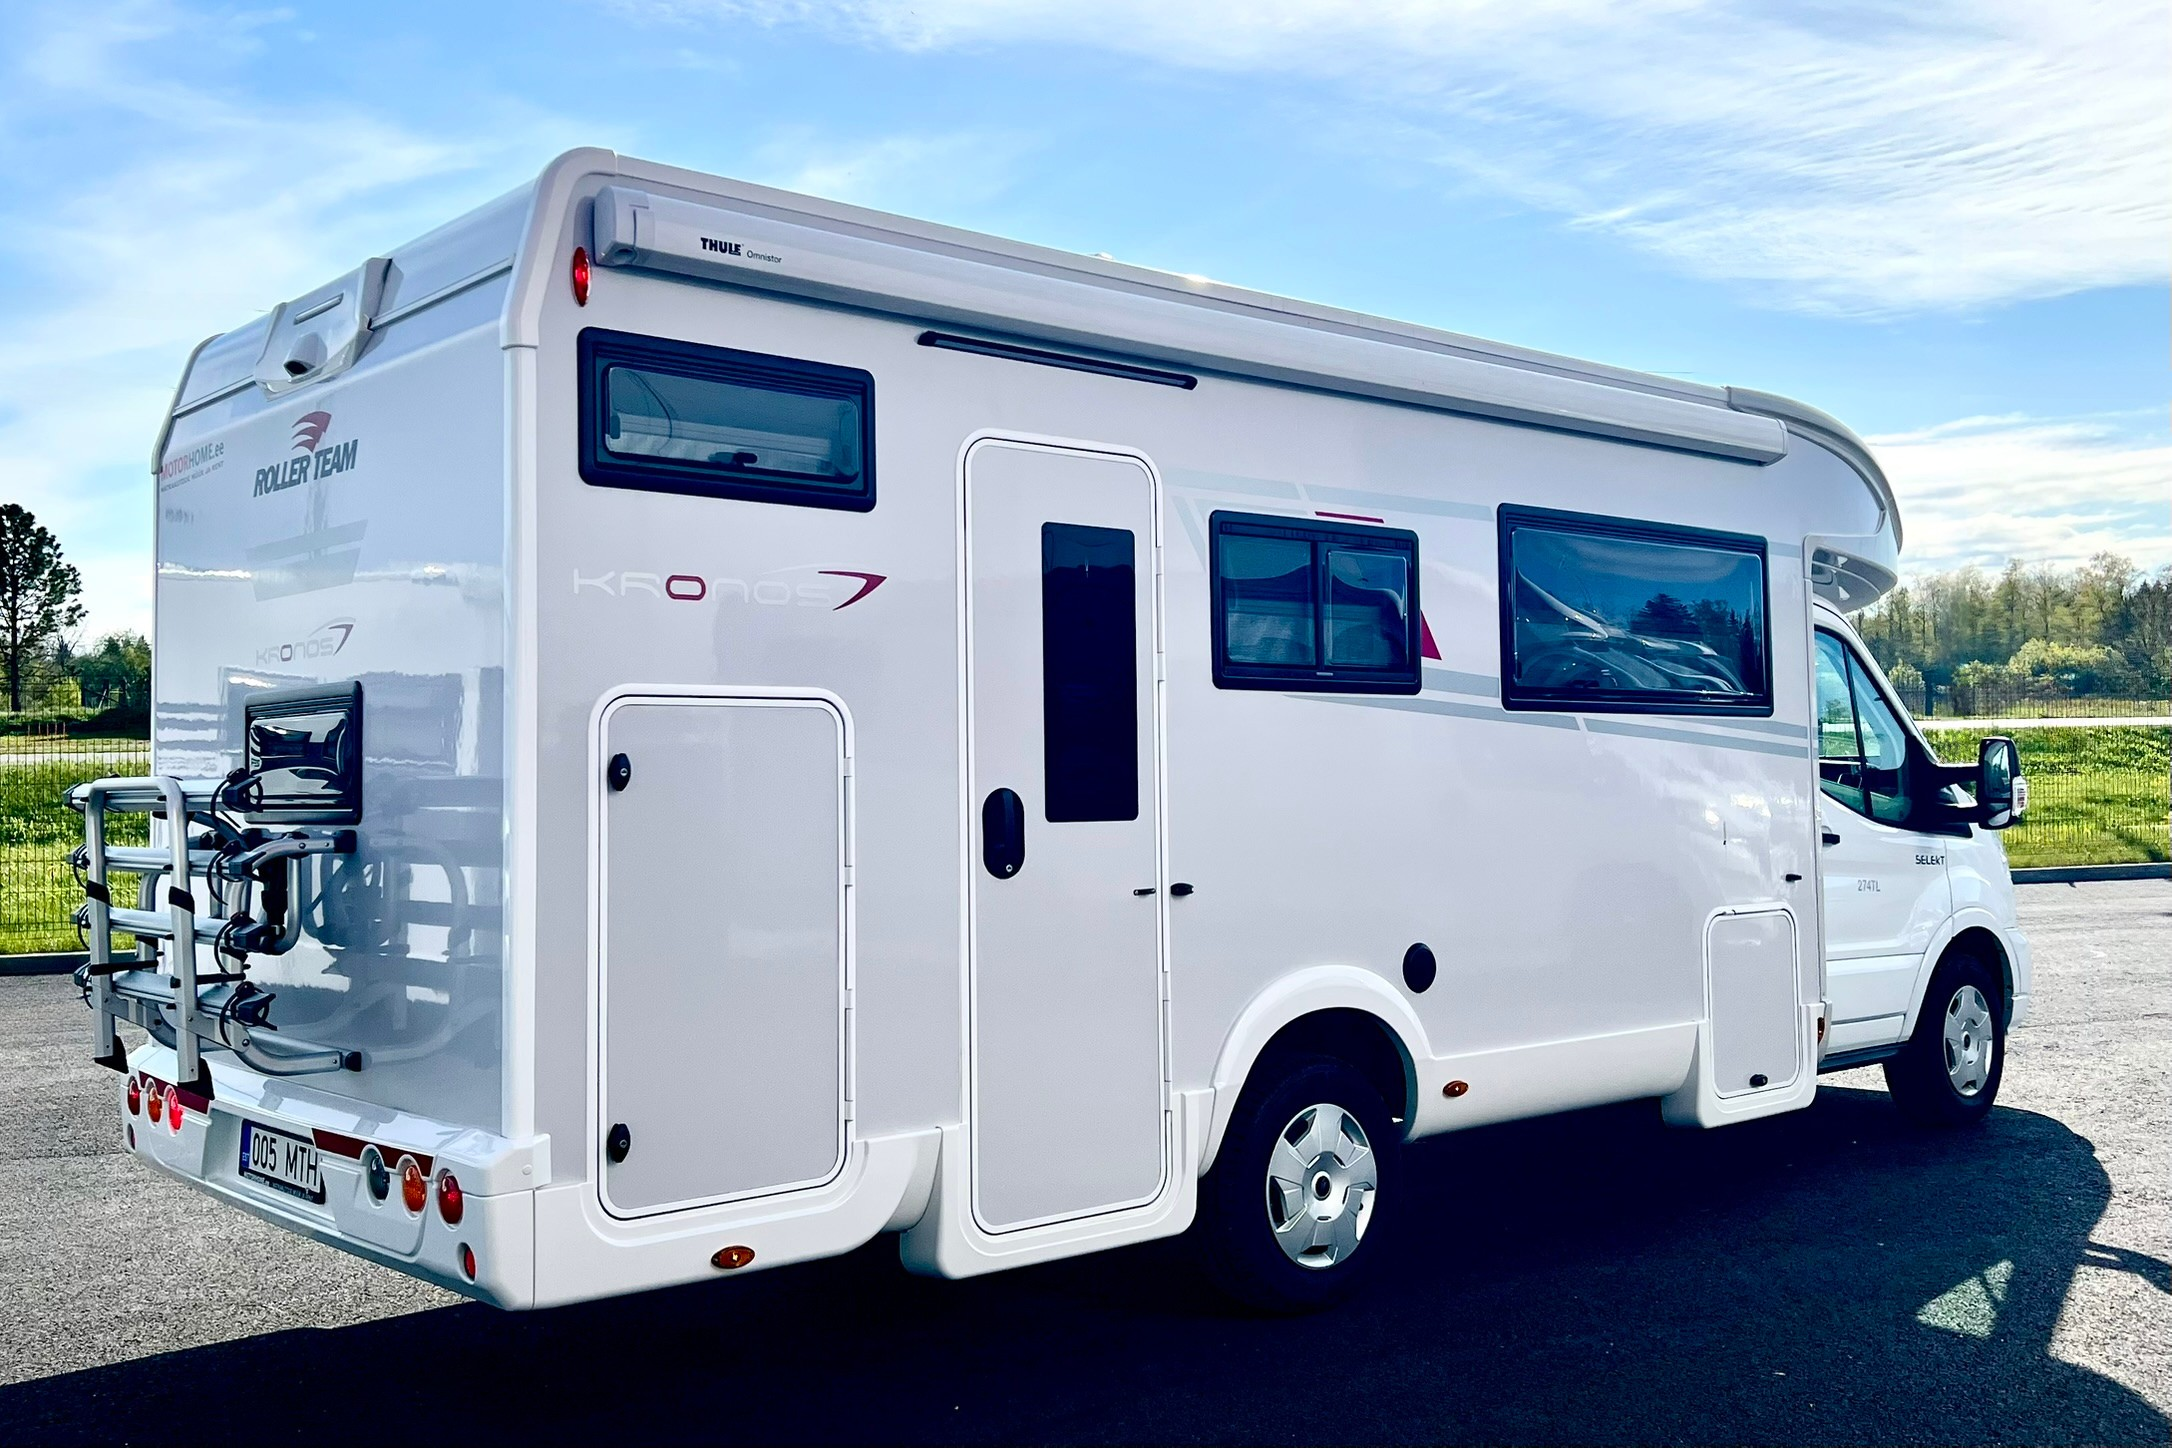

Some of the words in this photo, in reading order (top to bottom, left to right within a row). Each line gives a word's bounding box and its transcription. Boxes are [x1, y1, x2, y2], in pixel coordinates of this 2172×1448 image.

[700, 237, 742, 256] THULE
[746, 249, 782, 263] Omnistor
[253, 454, 311, 497] ROLLER
[313, 439, 359, 480] TEAM
[1857, 879, 1881, 892] 274TL
[252, 1132, 277, 1173] 005
[285, 1142, 318, 1187] MTH
